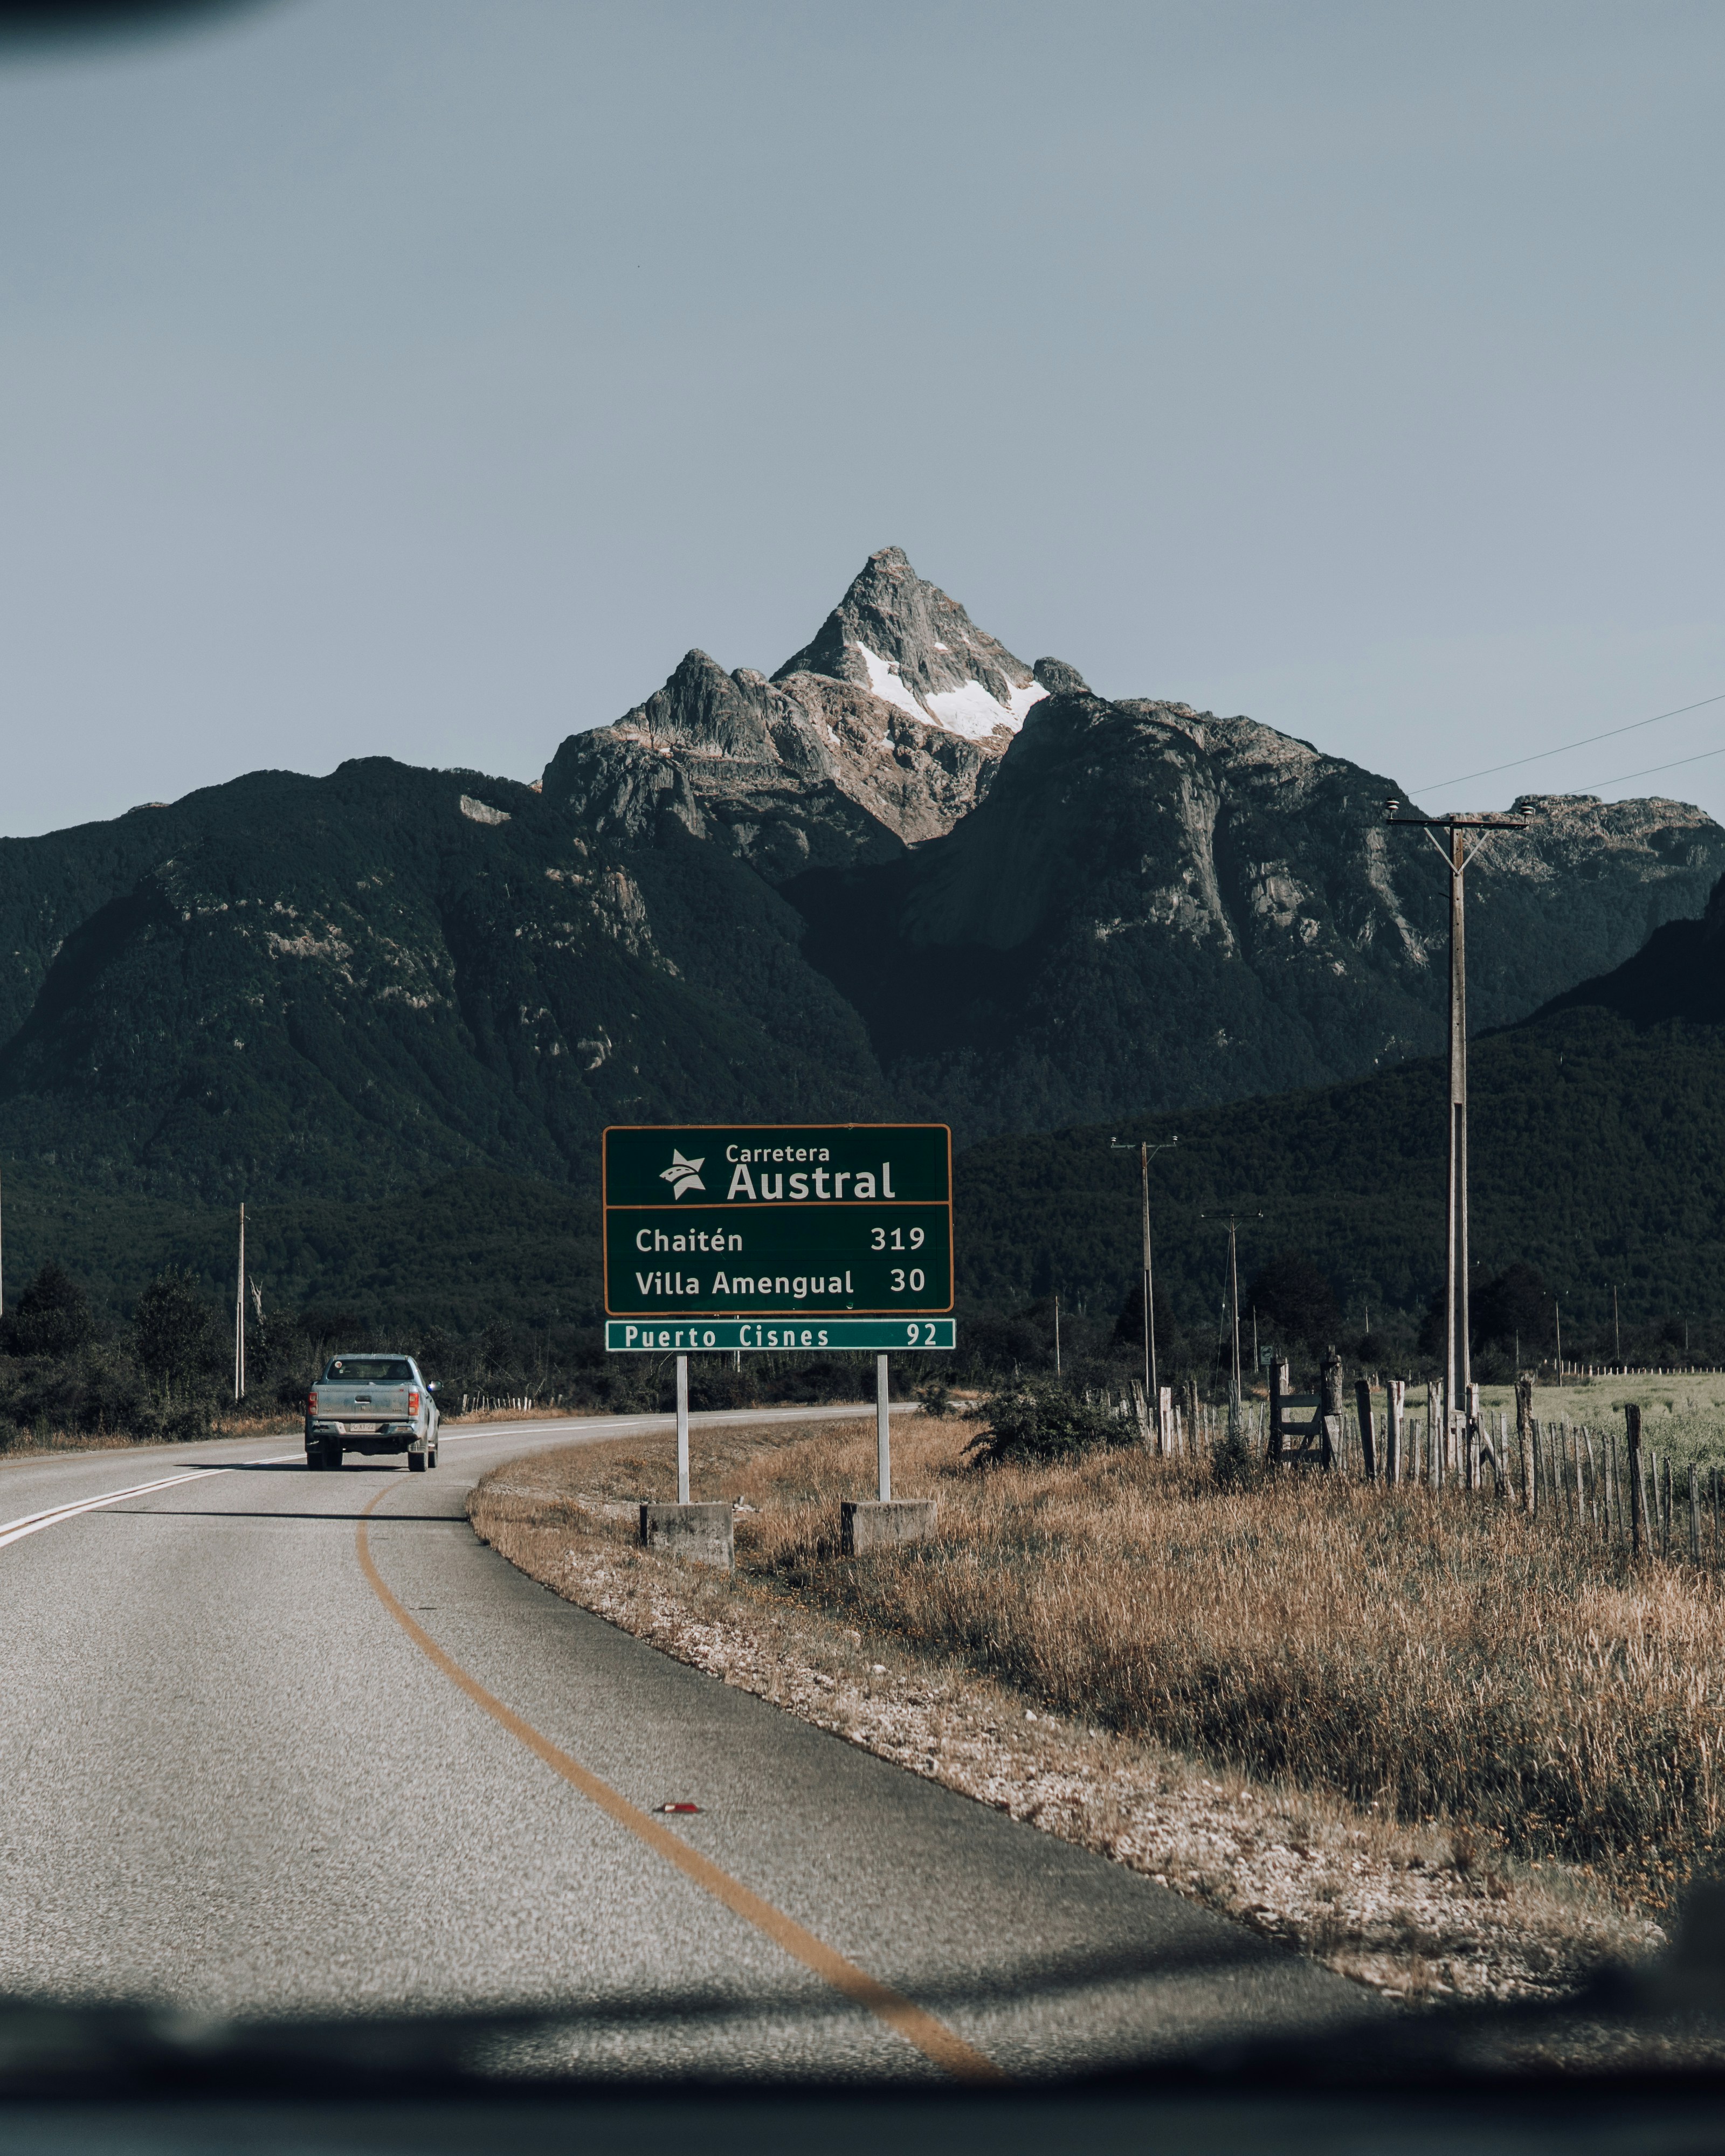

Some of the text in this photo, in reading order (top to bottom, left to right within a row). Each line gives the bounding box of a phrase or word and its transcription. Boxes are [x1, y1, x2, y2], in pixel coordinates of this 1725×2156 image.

[726, 1144, 830, 1162] Carretera
[727, 1162, 895, 1200] Austral
[636, 1227, 924, 1252] Chaitén 319
[636, 1268, 924, 1298] Villa Amengual 30
[625, 1323, 936, 1347] Puerto Cisnes 92
